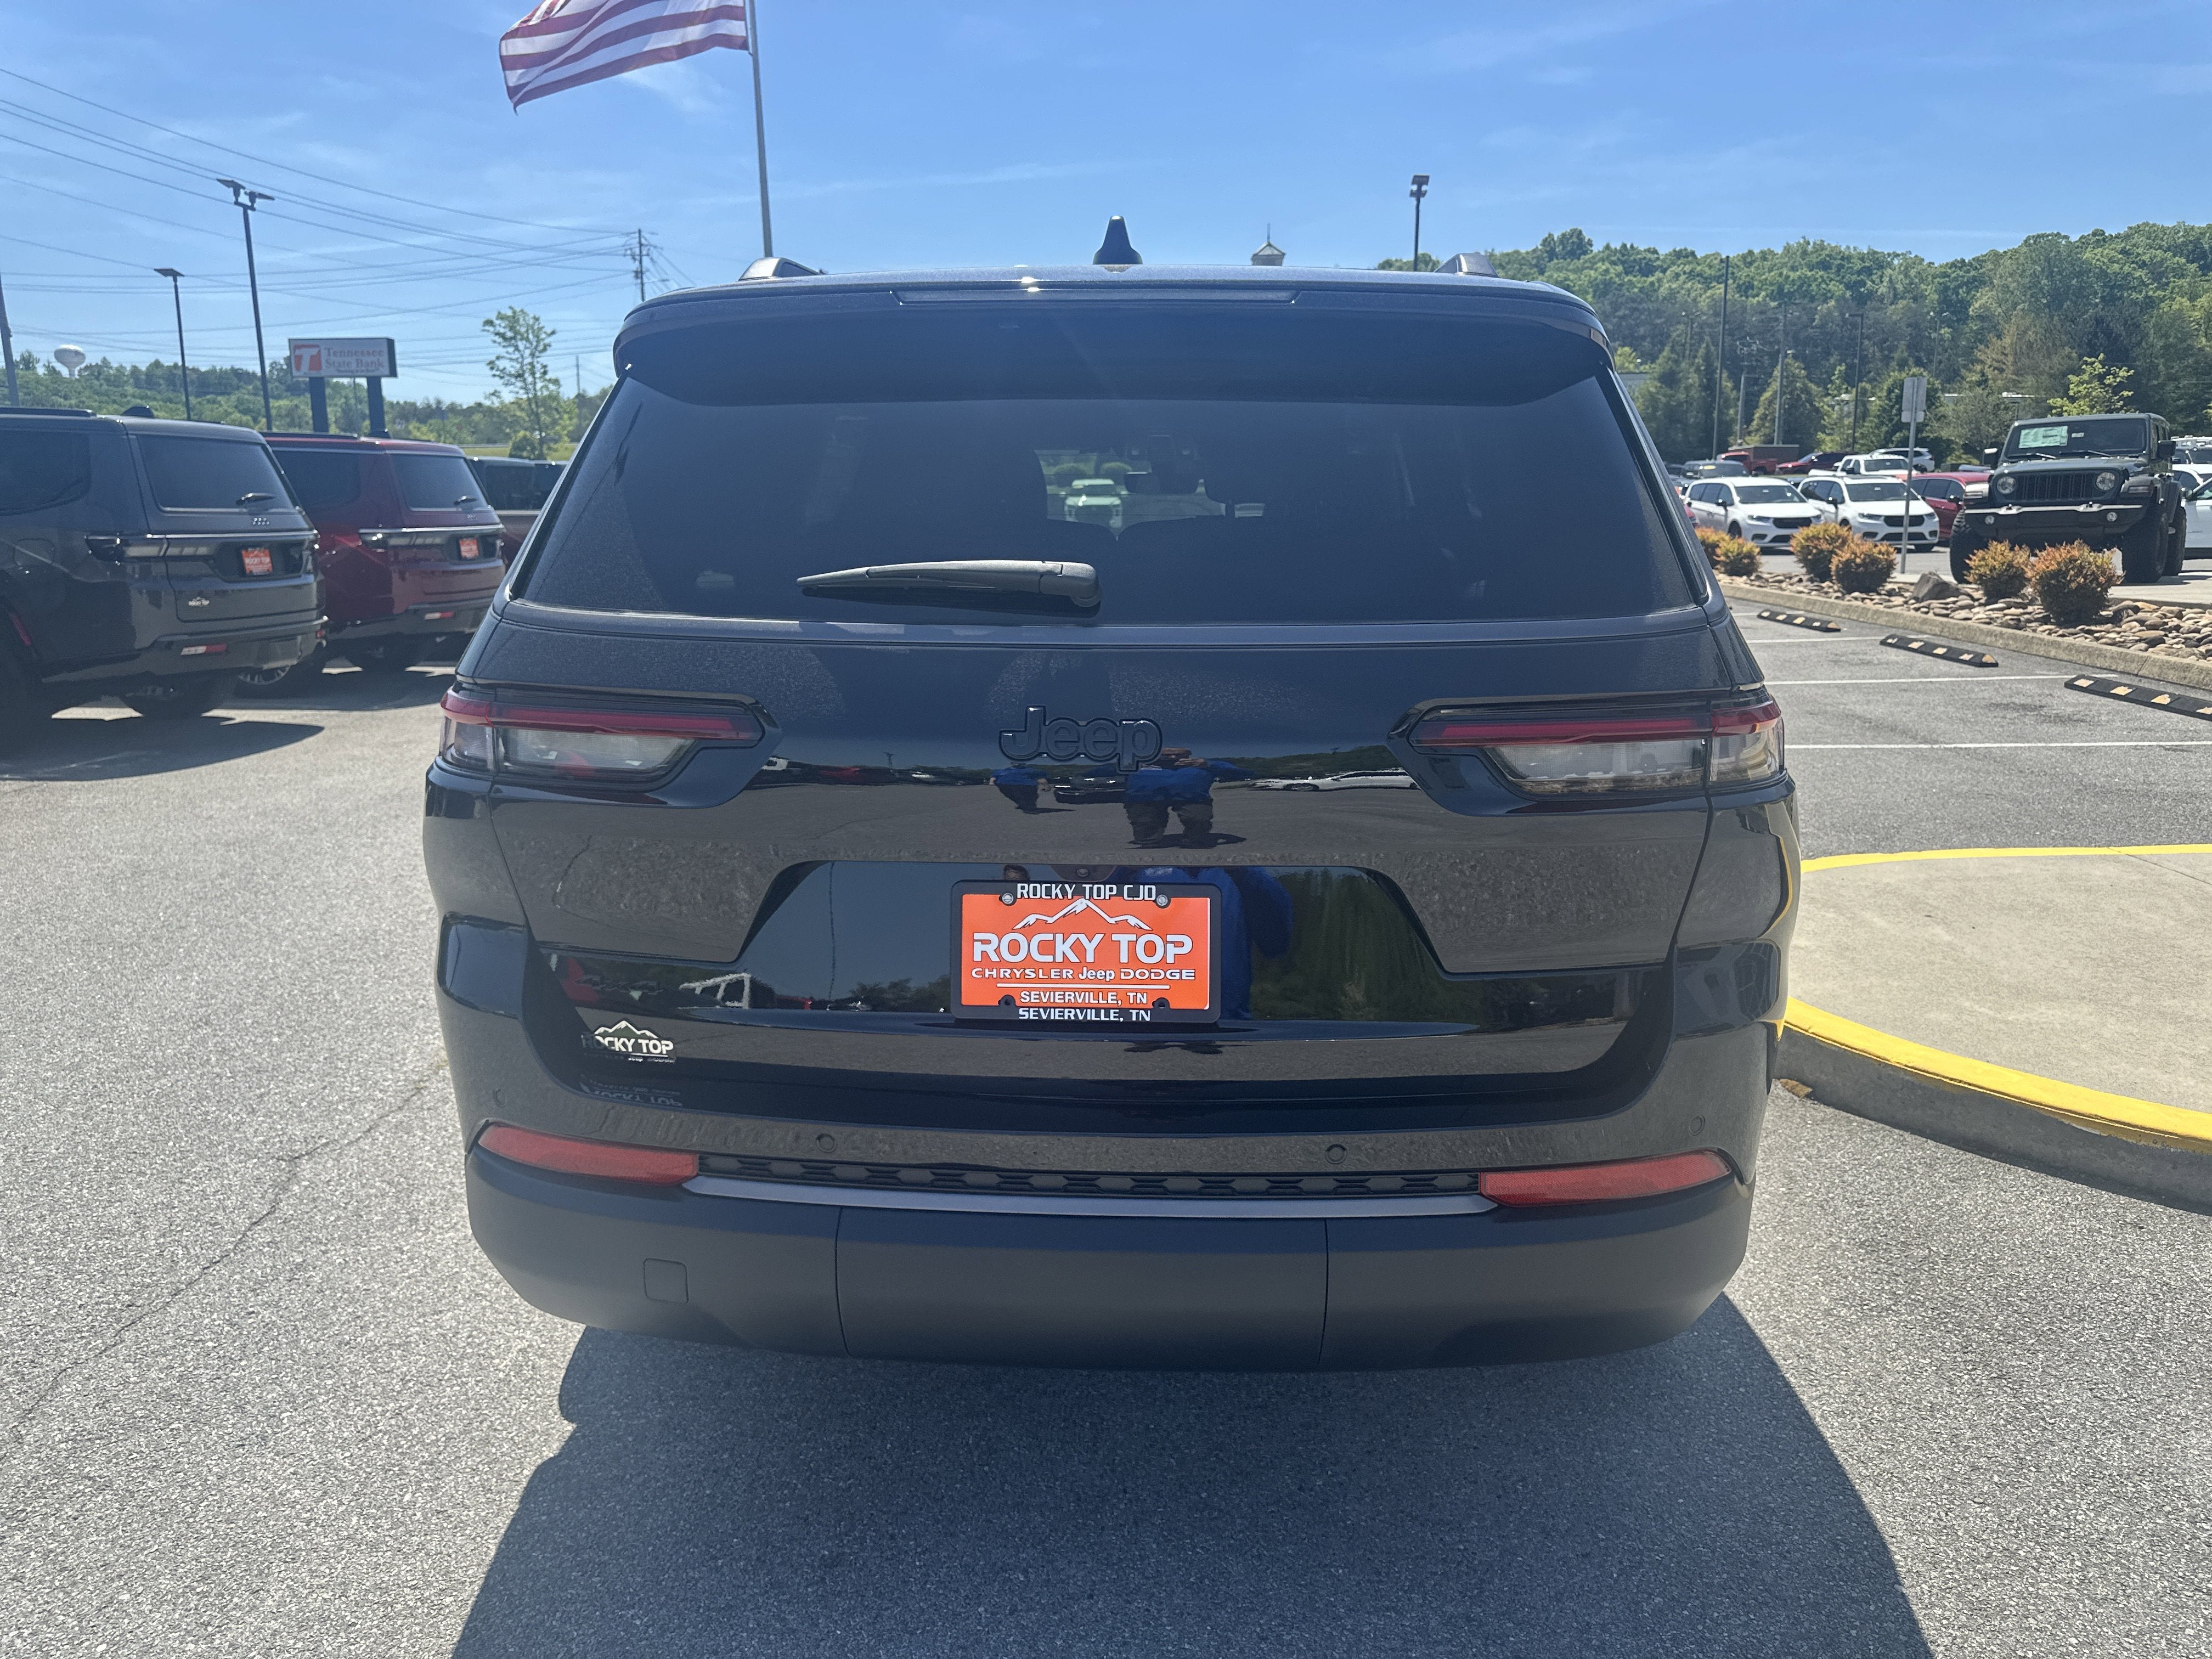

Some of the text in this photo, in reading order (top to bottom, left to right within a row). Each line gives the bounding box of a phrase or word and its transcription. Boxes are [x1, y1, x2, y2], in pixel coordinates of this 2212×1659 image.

[325, 347, 385, 358] Tennessee
[325, 358, 385, 369] State Bank
[999, 706, 1163, 774] Jeep
[1017, 883, 1156, 901] ROCKY TOP CJD
[973, 932, 1193, 964] ROCKY TOP
[971, 966, 1195, 982] CHRYSLER Jeep DODGE
[1020, 990, 1148, 1006] SEVIERVILLE, TN
[1019, 1007, 1150, 1022] SEVIERVILLE, TN
[638, 1039, 674, 1054] TOP
